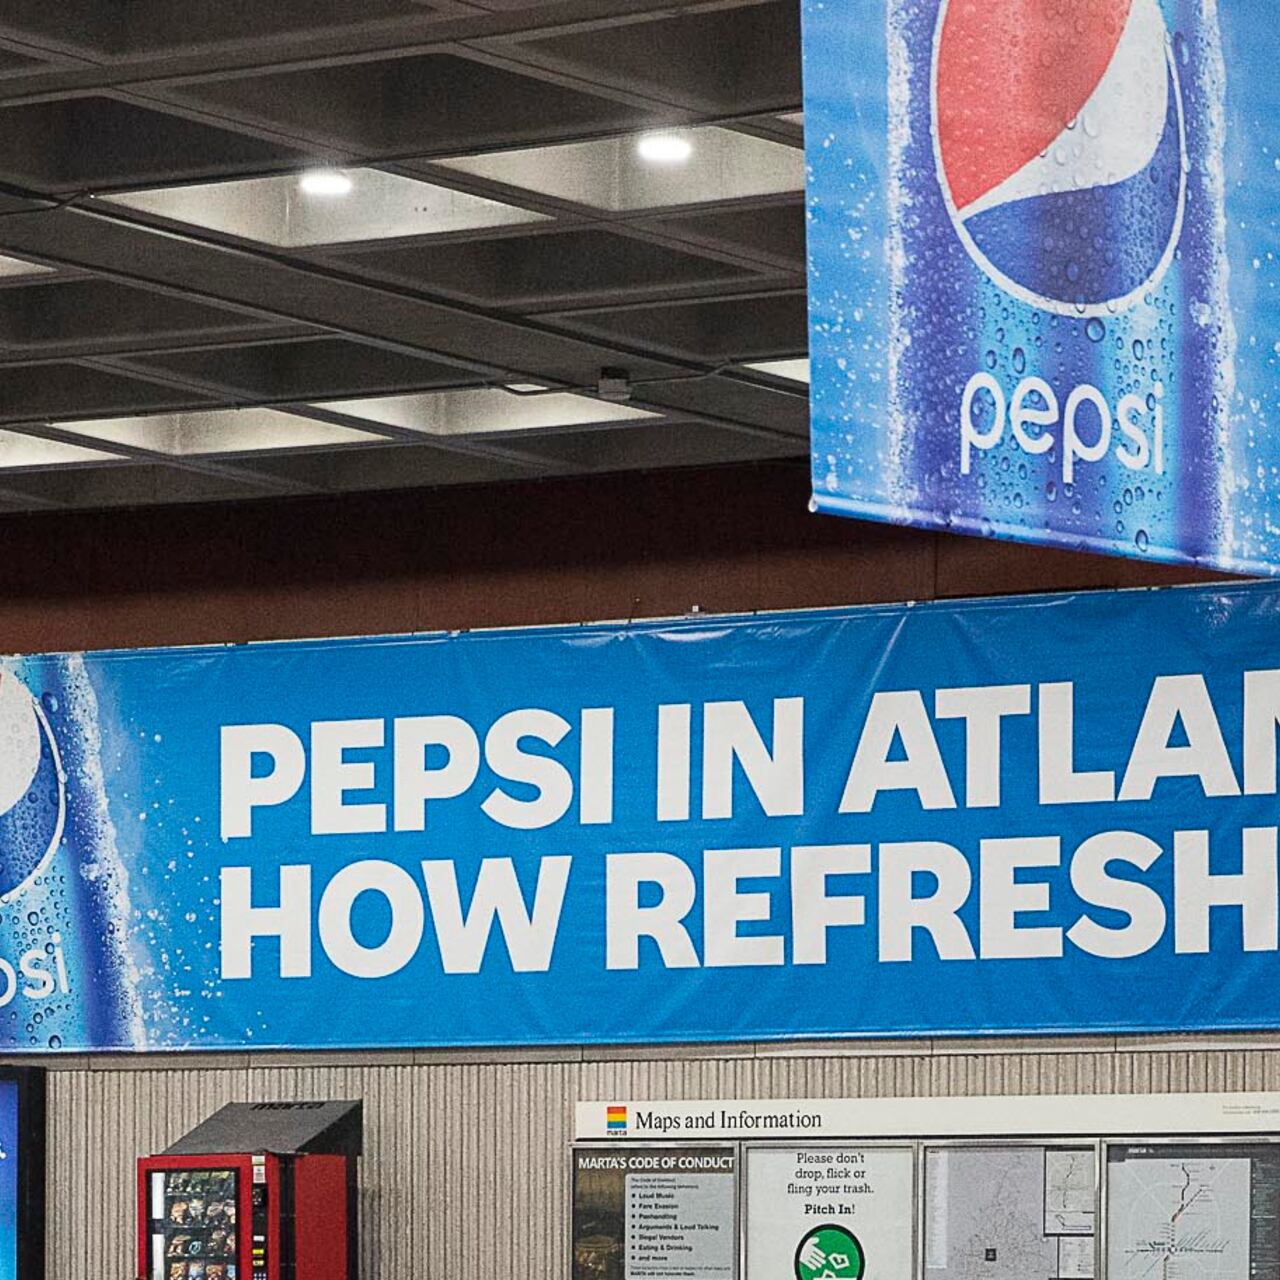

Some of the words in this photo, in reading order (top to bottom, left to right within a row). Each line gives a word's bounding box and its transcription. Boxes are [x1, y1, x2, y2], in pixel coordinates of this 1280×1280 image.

[960, 371, 1164, 484] pepsi
[219, 707, 615, 839] PEPSI
[656, 696, 805, 822] IN
[219, 854, 573, 980] HOW
[635, 1111, 681, 1133] Maps
[684, 1110, 716, 1129] and
[720, 1109, 822, 1129] Information
[577, 1157, 627, 1169] MARTA'S
[627, 1157, 660, 1169] CODE
[661, 1157, 677, 1169] OF
[677, 1156, 735, 1169] CONDUCT
[796, 1152, 833, 1164] Please
[836, 1152, 865, 1164] don't
[794, 1167, 825, 1181] drop,
[826, 1167, 851, 1179] flick
[853, 1169, 866, 1179] or
[787, 1183, 812, 1196] fling
[815, 1184, 840, 1196] your
[843, 1182, 874, 1194] trash.
[804, 1203, 836, 1215] Pitch
[837, 1203, 856, 1215] In!
